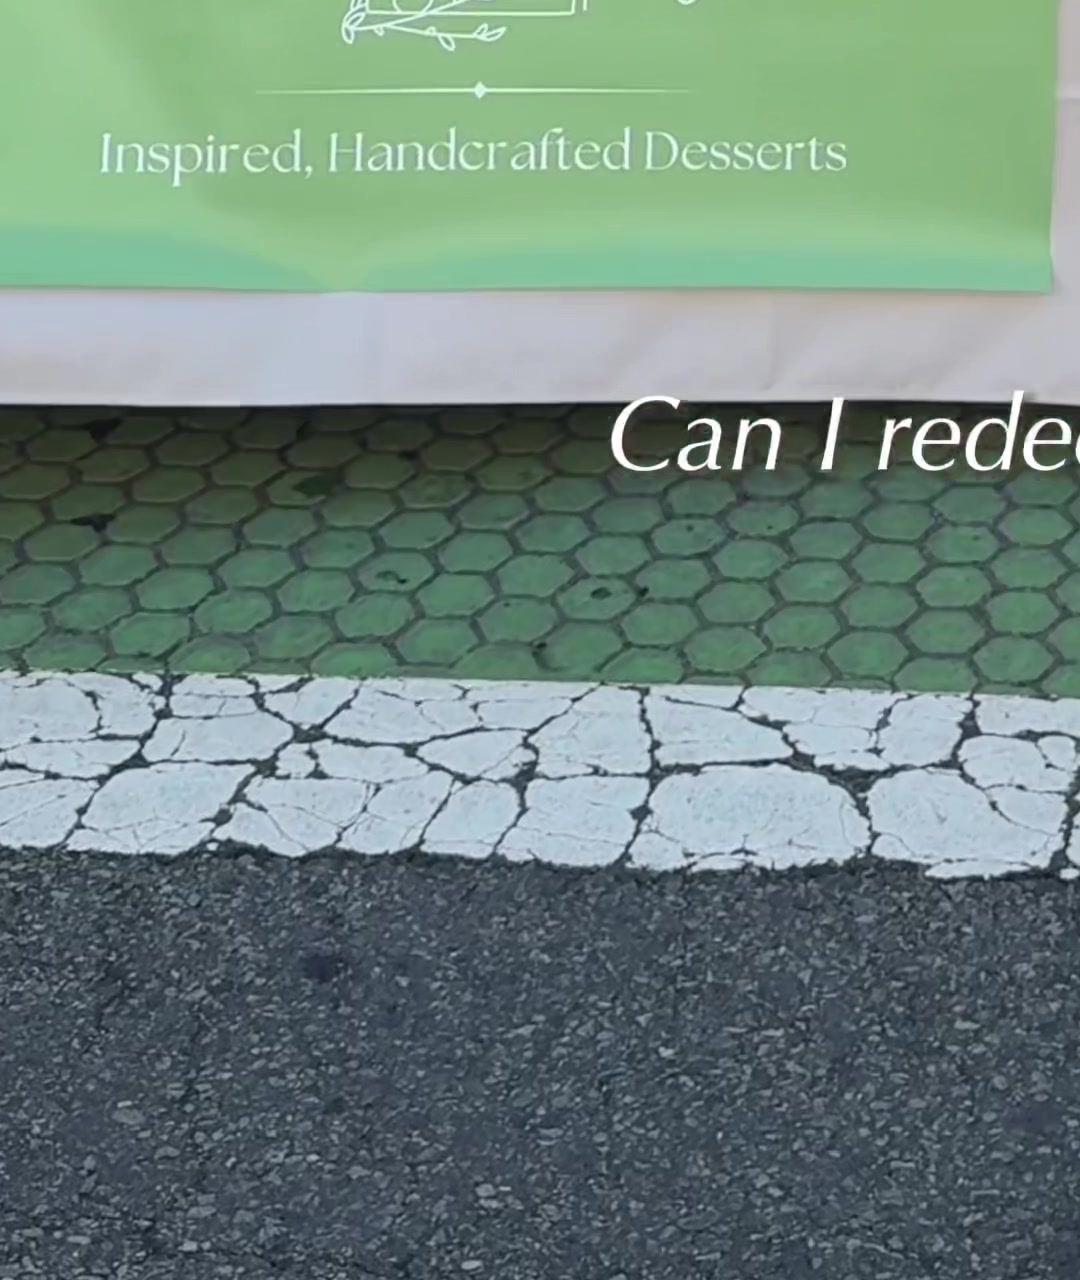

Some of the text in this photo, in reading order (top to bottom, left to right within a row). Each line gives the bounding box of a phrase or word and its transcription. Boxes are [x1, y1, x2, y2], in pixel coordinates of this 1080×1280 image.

[100, 125, 848, 188] Inspired, Handcrafted Desserts
